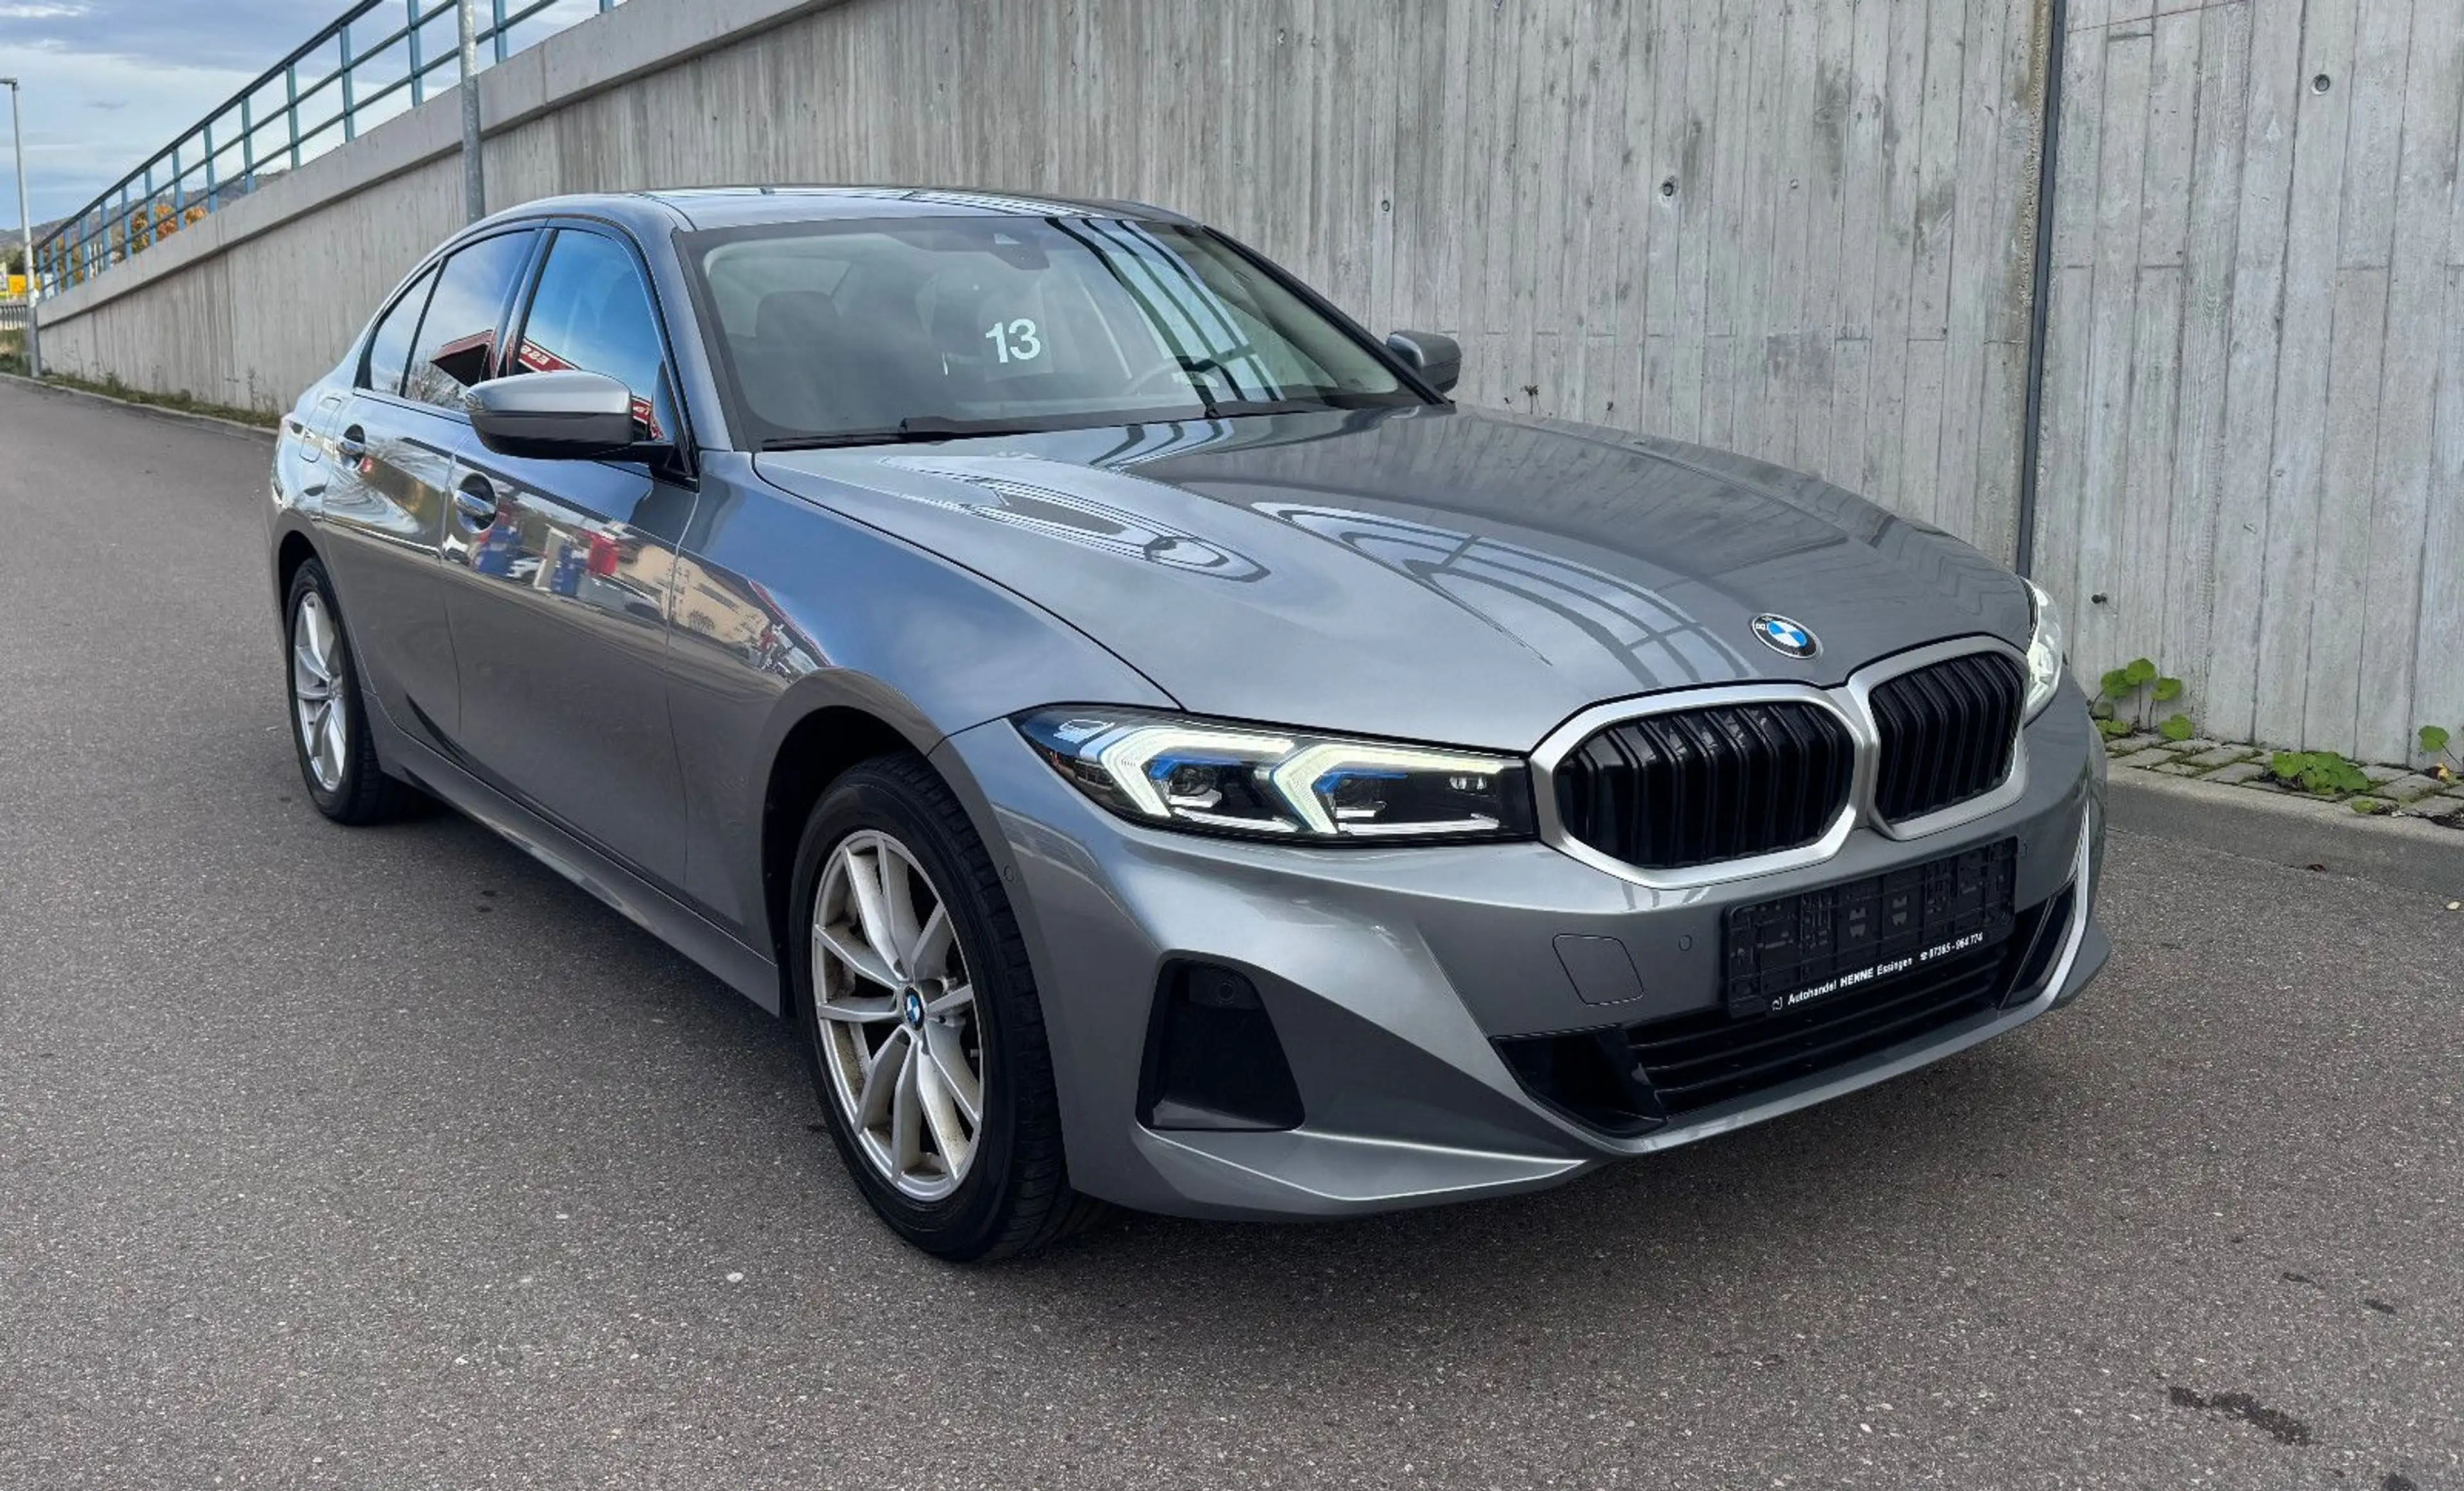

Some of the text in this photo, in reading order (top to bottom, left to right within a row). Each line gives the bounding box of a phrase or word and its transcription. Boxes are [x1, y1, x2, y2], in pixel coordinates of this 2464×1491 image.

[985, 318, 1041, 364] 13
[1788, 979, 1836, 1005] Autohandel
[1840, 967, 1874, 988] HENNE
[1877, 958, 1912, 976] Essingen
